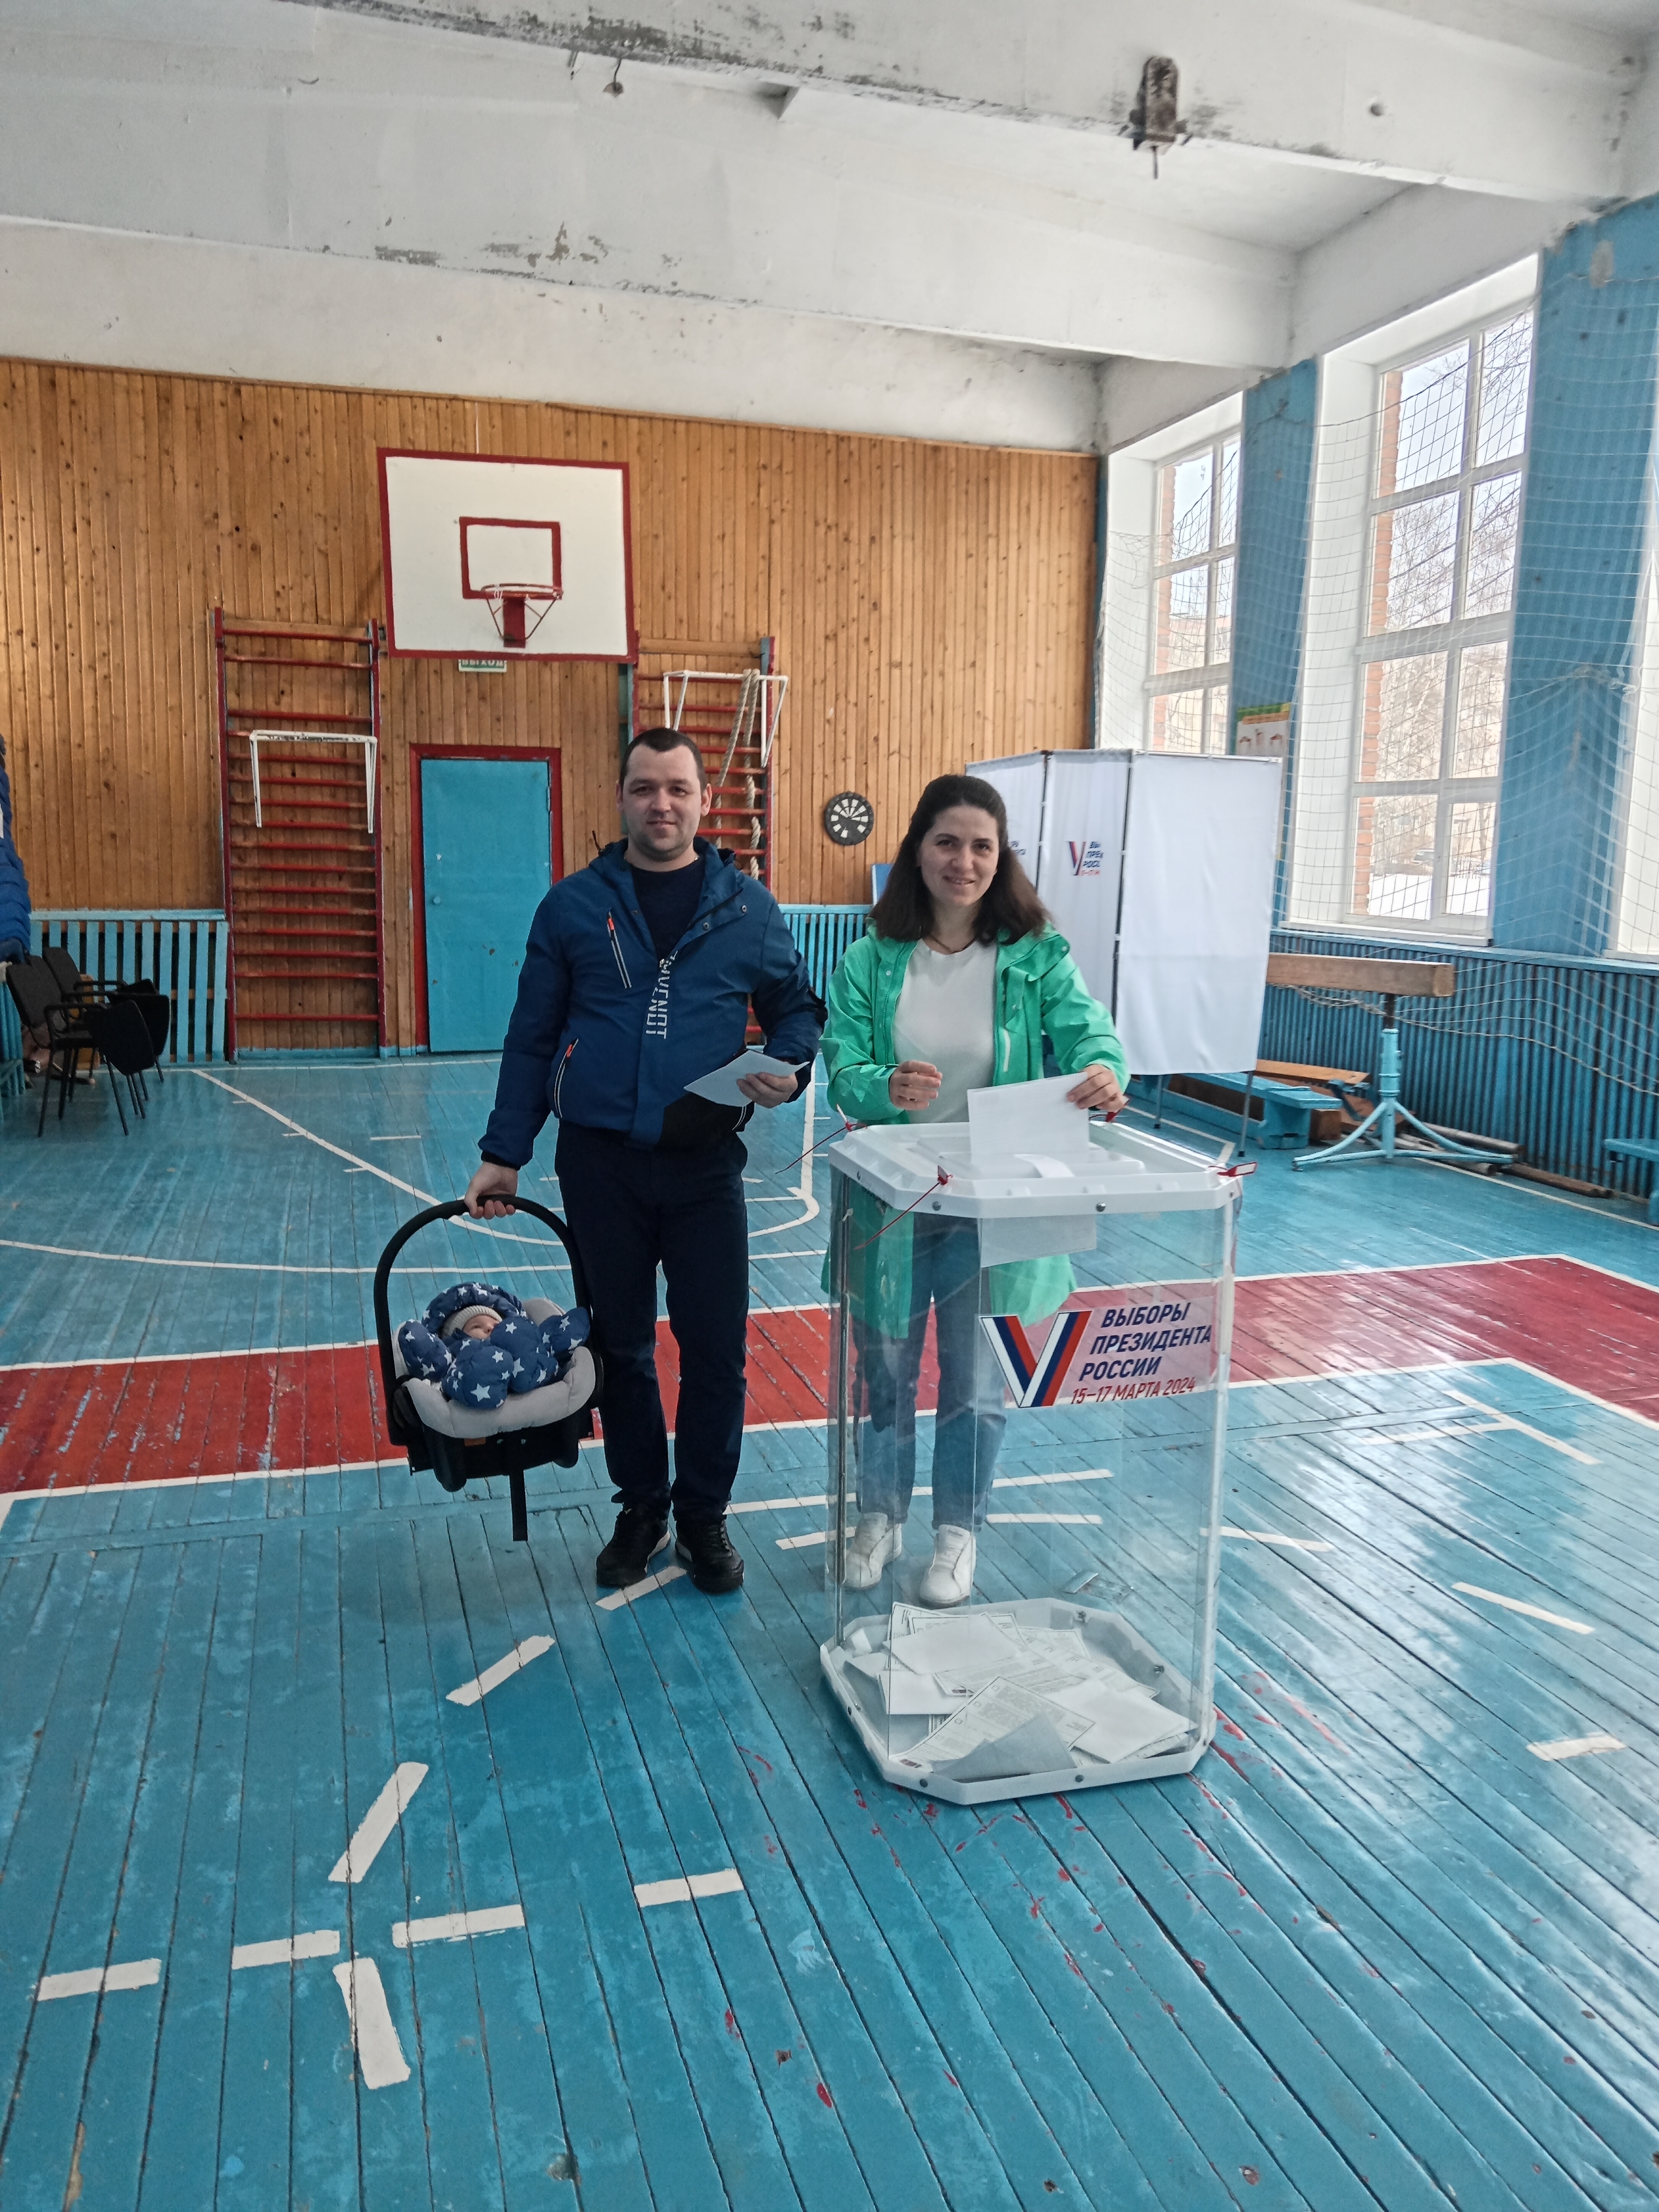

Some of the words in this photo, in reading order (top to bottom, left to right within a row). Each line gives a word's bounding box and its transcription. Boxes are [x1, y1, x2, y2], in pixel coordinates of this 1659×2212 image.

[1101, 1302, 1191, 1328] ВЫБОРЫ
[1089, 1324, 1212, 1355] ПРЕЗИДЕНТА
[1079, 1356, 1163, 1381] РОССИИ
[1111, 1381, 1162, 1401] МАРТА
[1162, 1376, 1196, 1396] 2024
